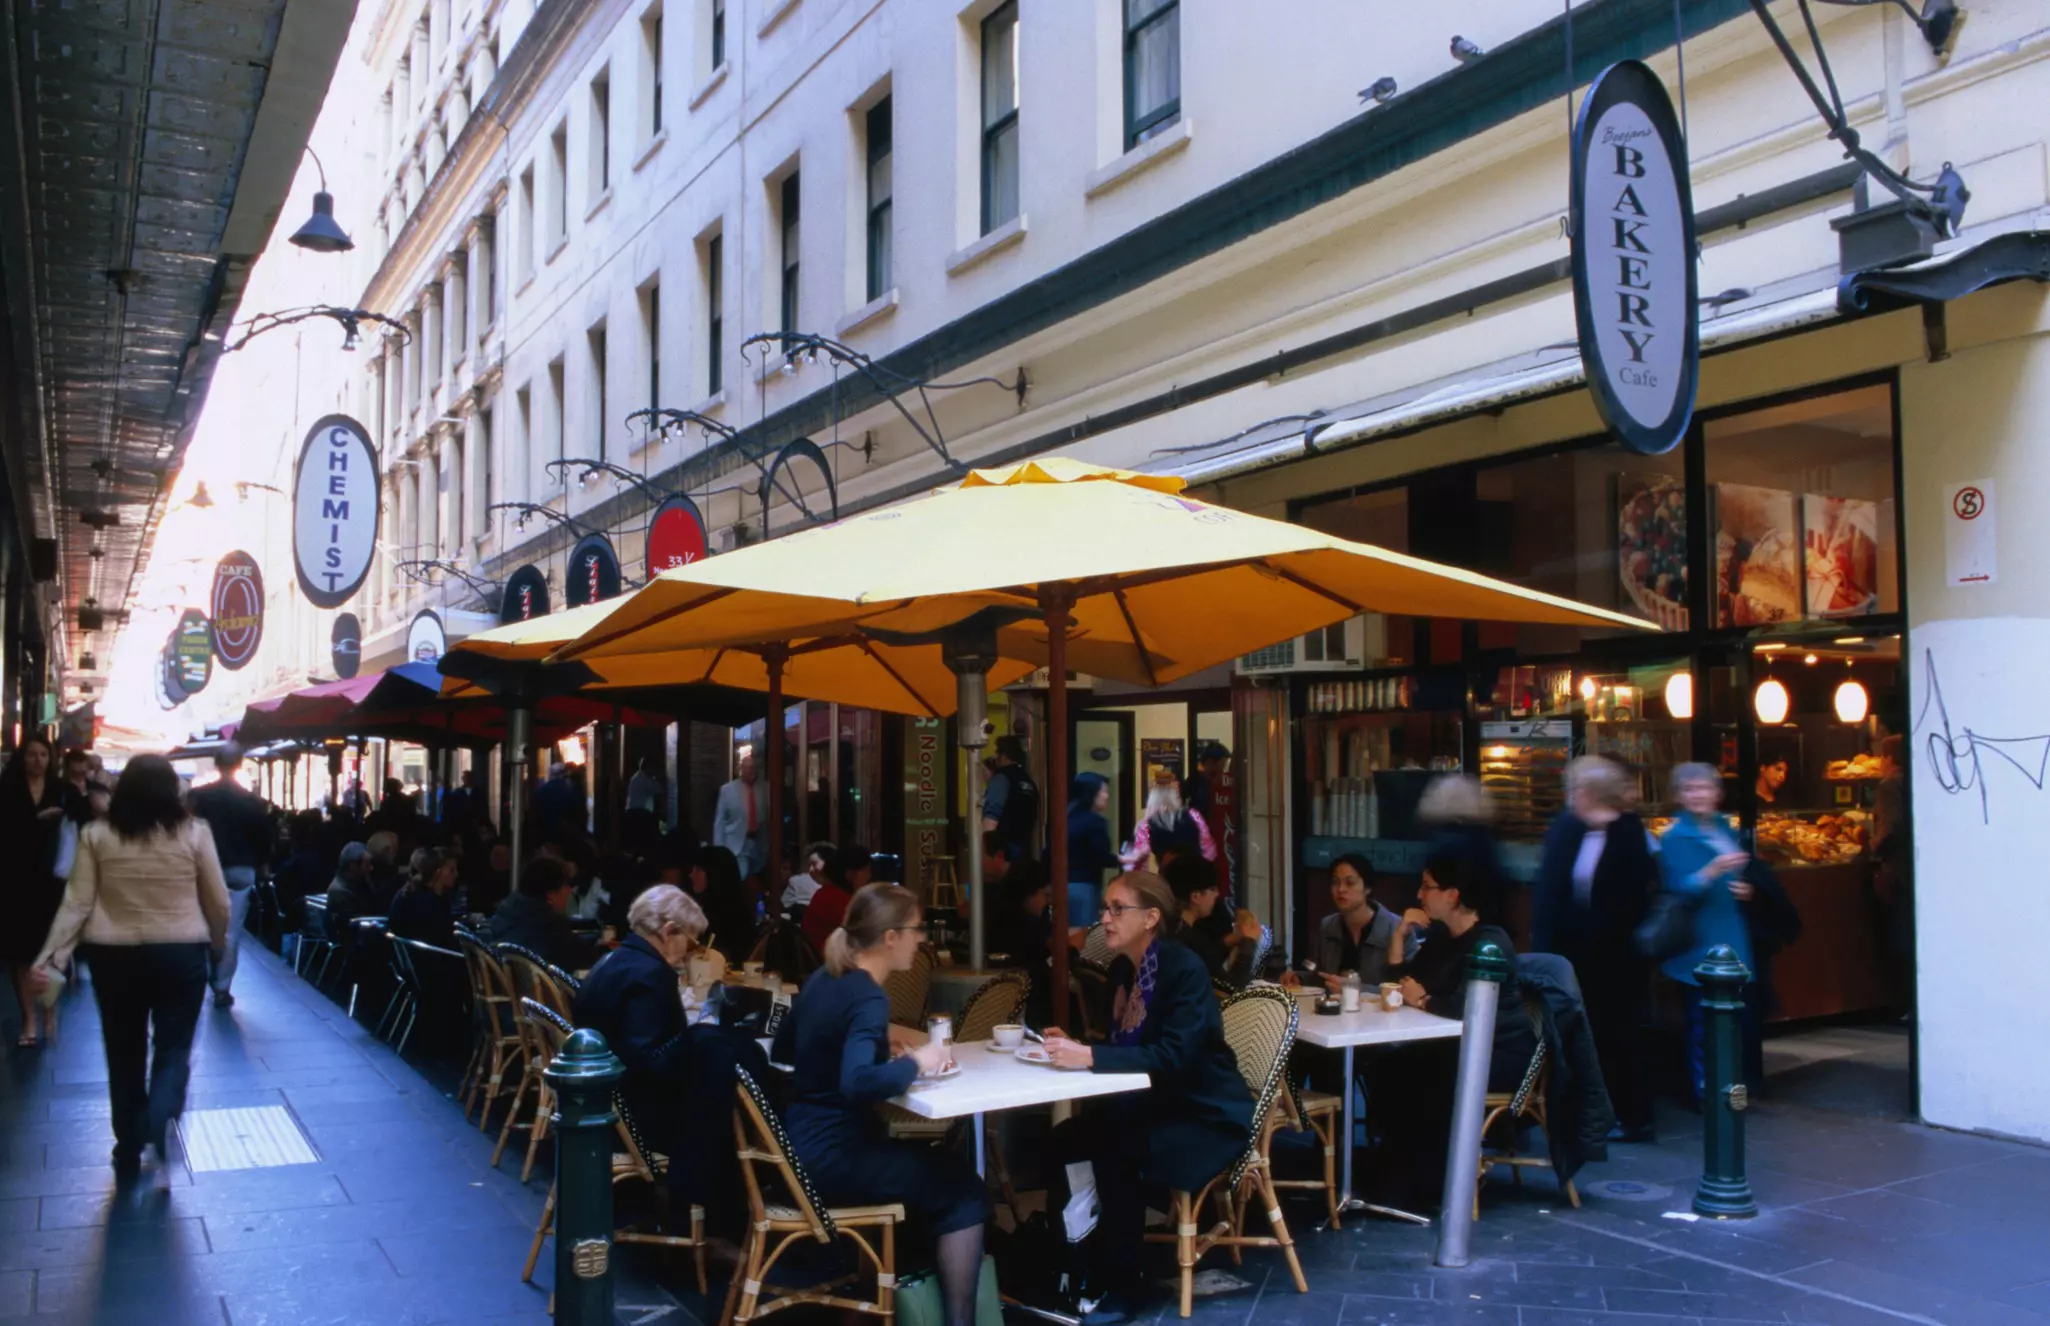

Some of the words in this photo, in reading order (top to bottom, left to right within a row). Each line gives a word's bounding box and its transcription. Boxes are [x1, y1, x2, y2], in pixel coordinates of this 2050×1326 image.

[1611, 145, 1654, 363] BAKERY
[1619, 366, 1658, 388] Cafe
[322, 427, 349, 592] CHEMIST
[919, 735, 936, 813] Noodle
